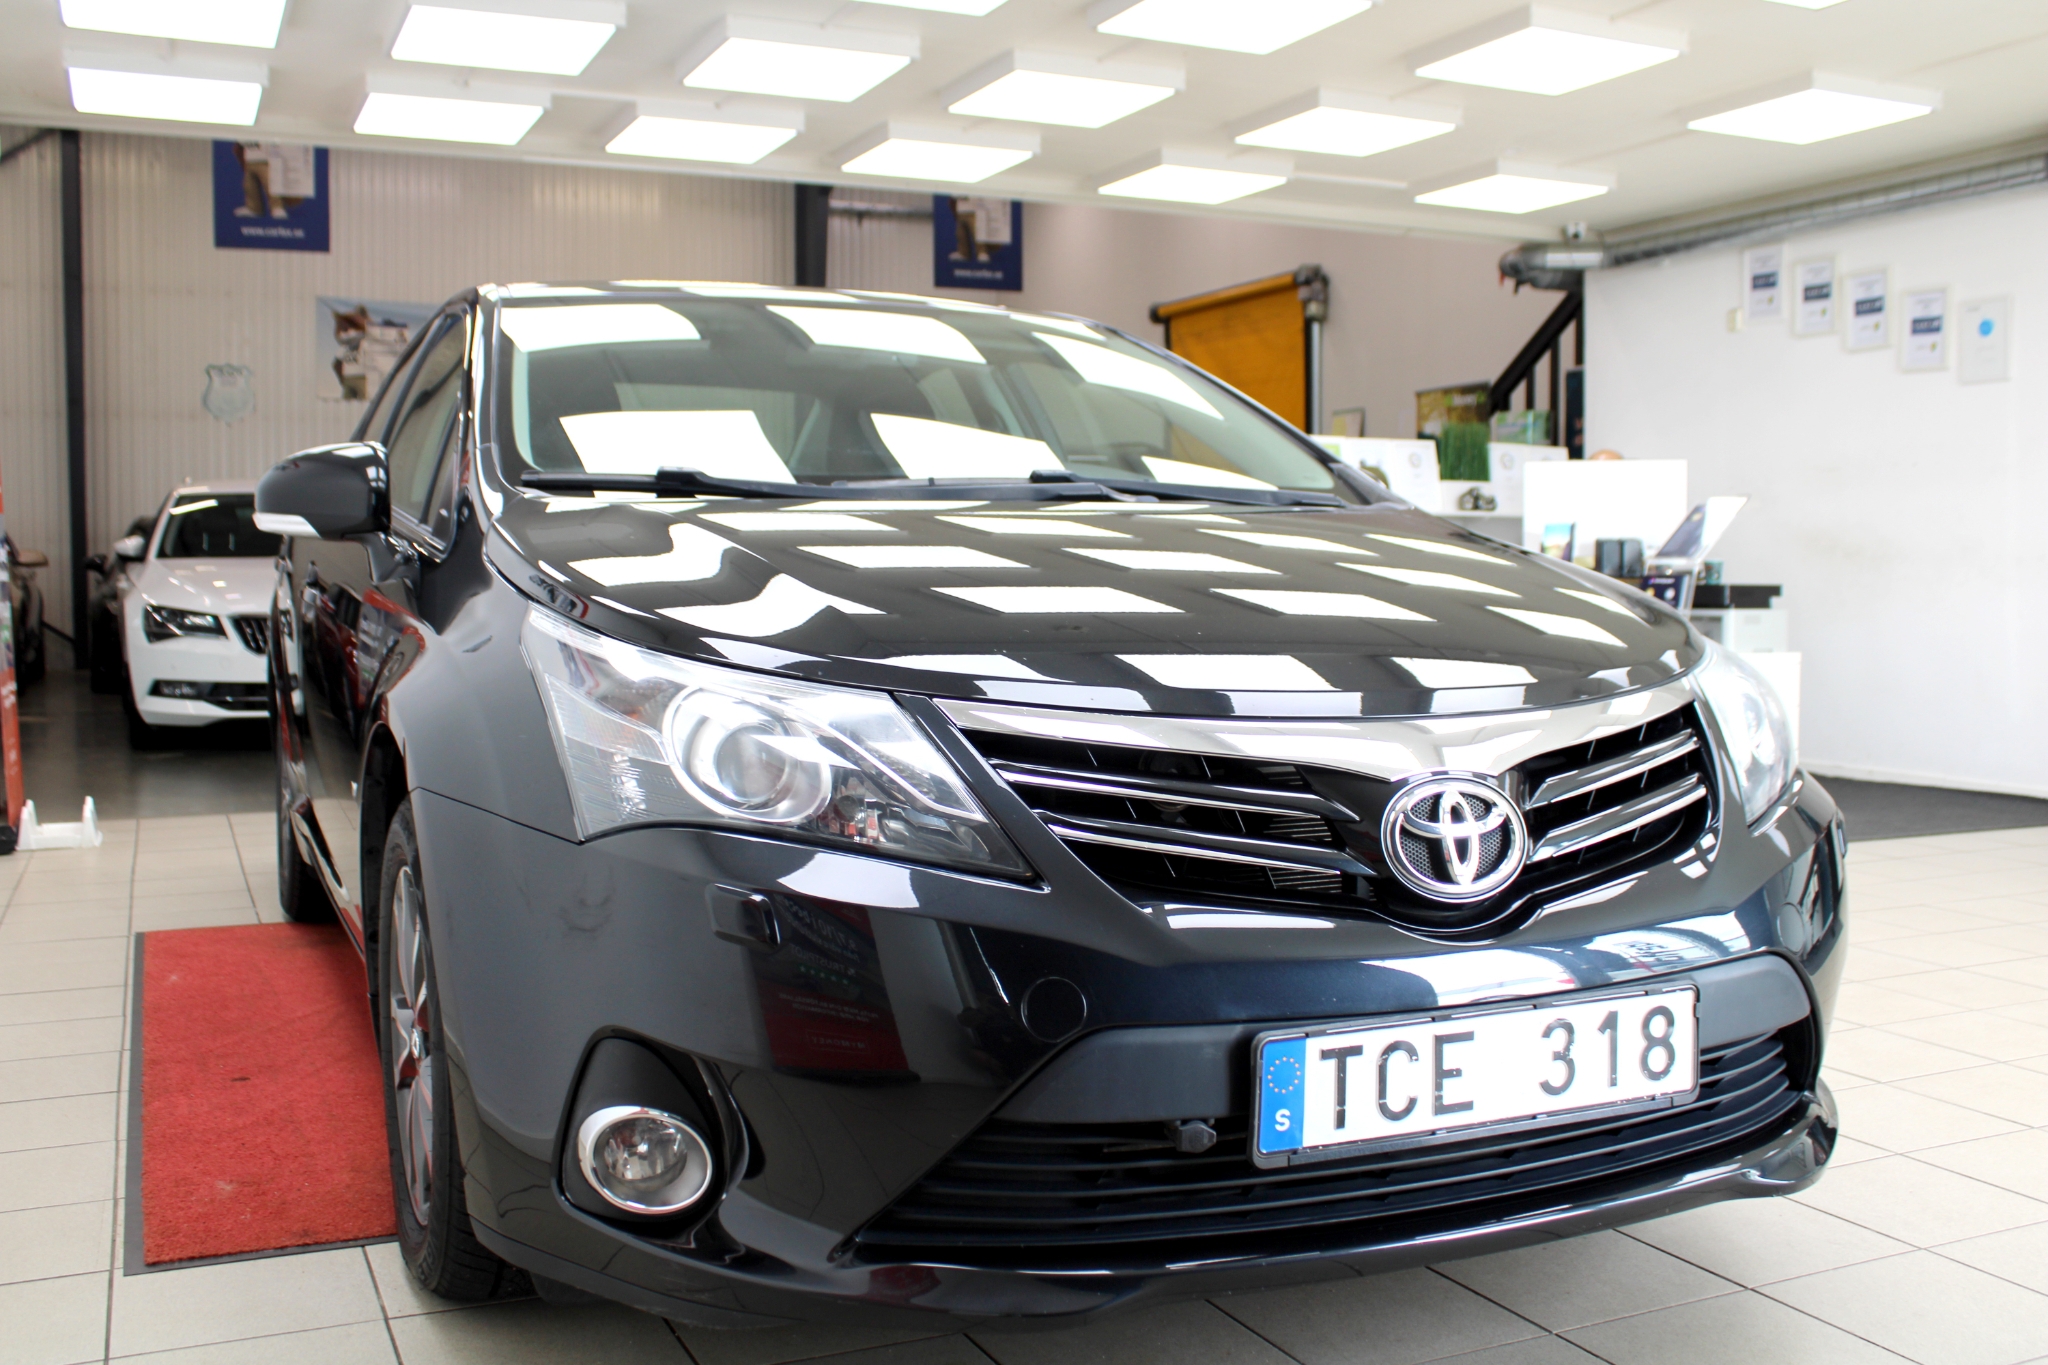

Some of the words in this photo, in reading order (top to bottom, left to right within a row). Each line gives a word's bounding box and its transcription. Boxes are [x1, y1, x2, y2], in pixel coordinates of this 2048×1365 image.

[1318, 1030, 1475, 1131] TCE
[1539, 1005, 1677, 1096] 318
[1274, 1108, 1291, 1132] S
